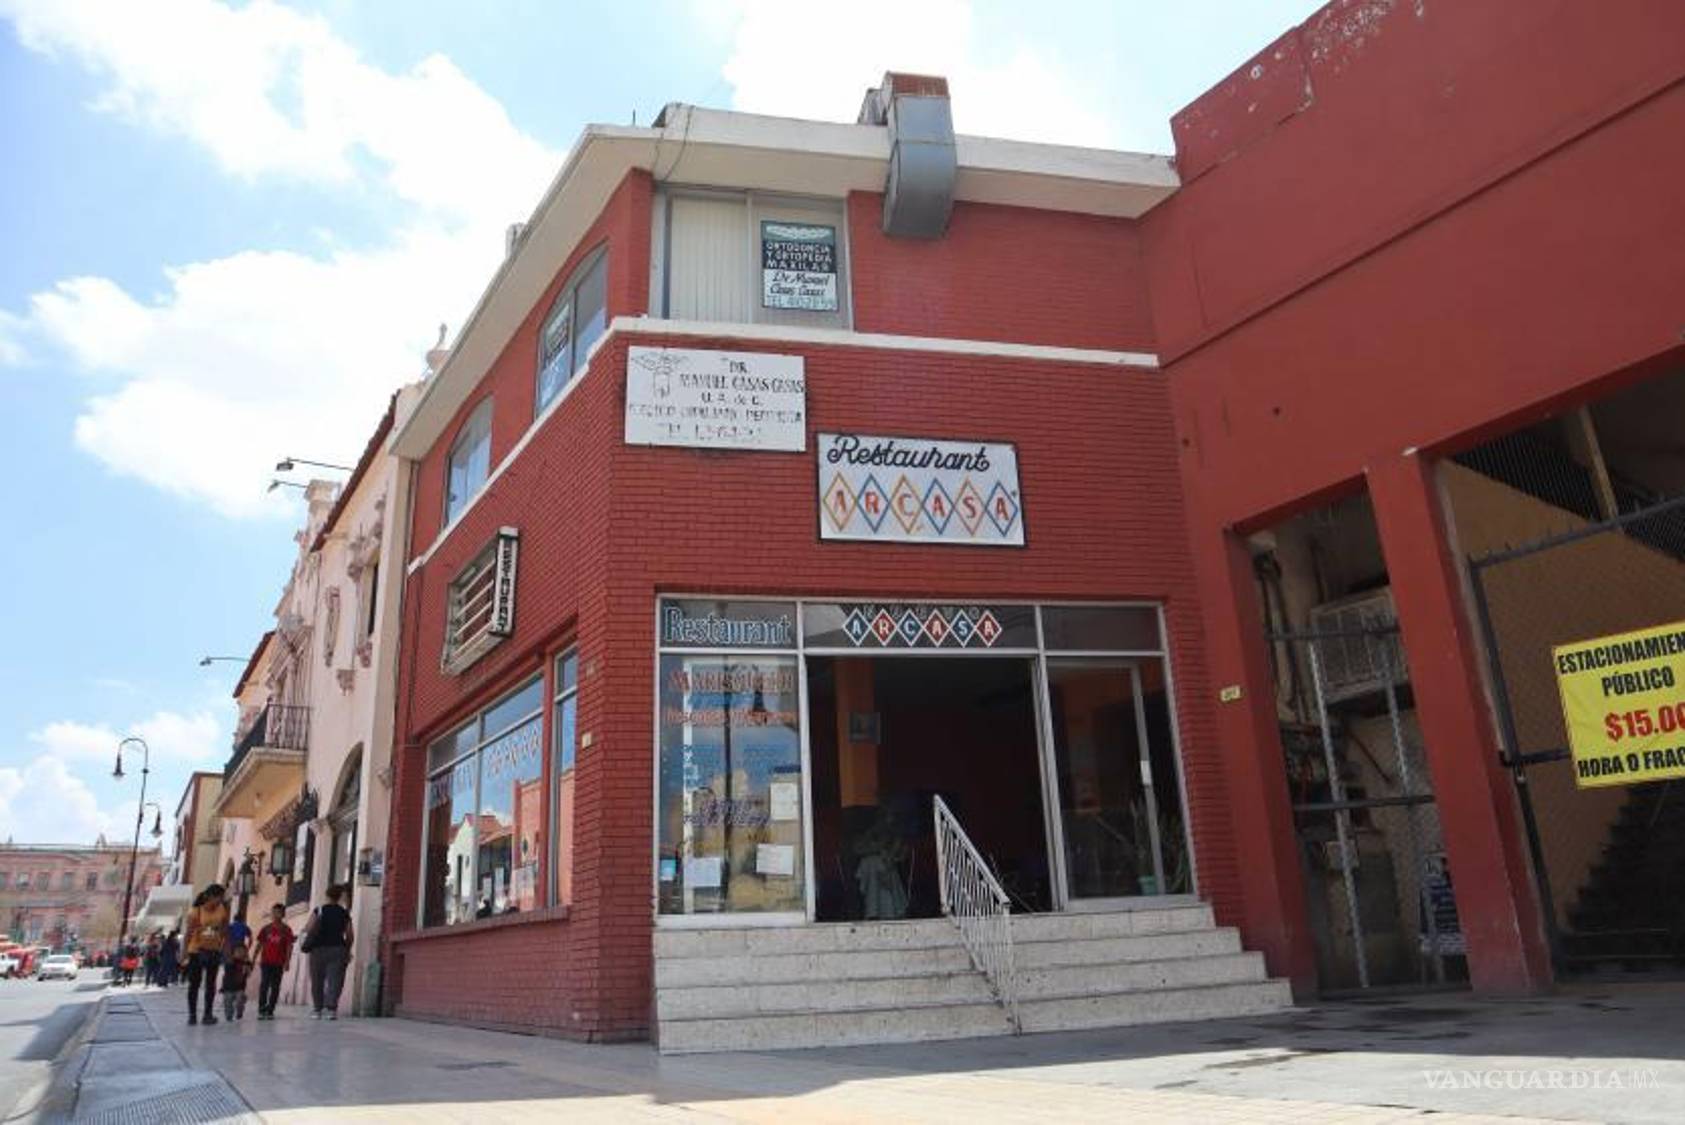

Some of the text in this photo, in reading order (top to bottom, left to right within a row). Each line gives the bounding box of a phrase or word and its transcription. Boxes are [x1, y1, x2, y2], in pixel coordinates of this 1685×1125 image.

[827, 434, 991, 473] Restaurant
[663, 605, 793, 646] Restaurant
[1557, 630, 1685, 675] ESTACIONAMIEN
[1602, 665, 1676, 697] PÚBLICO
[1577, 755, 1625, 778] HORA
[1626, 752, 1639, 772] O
